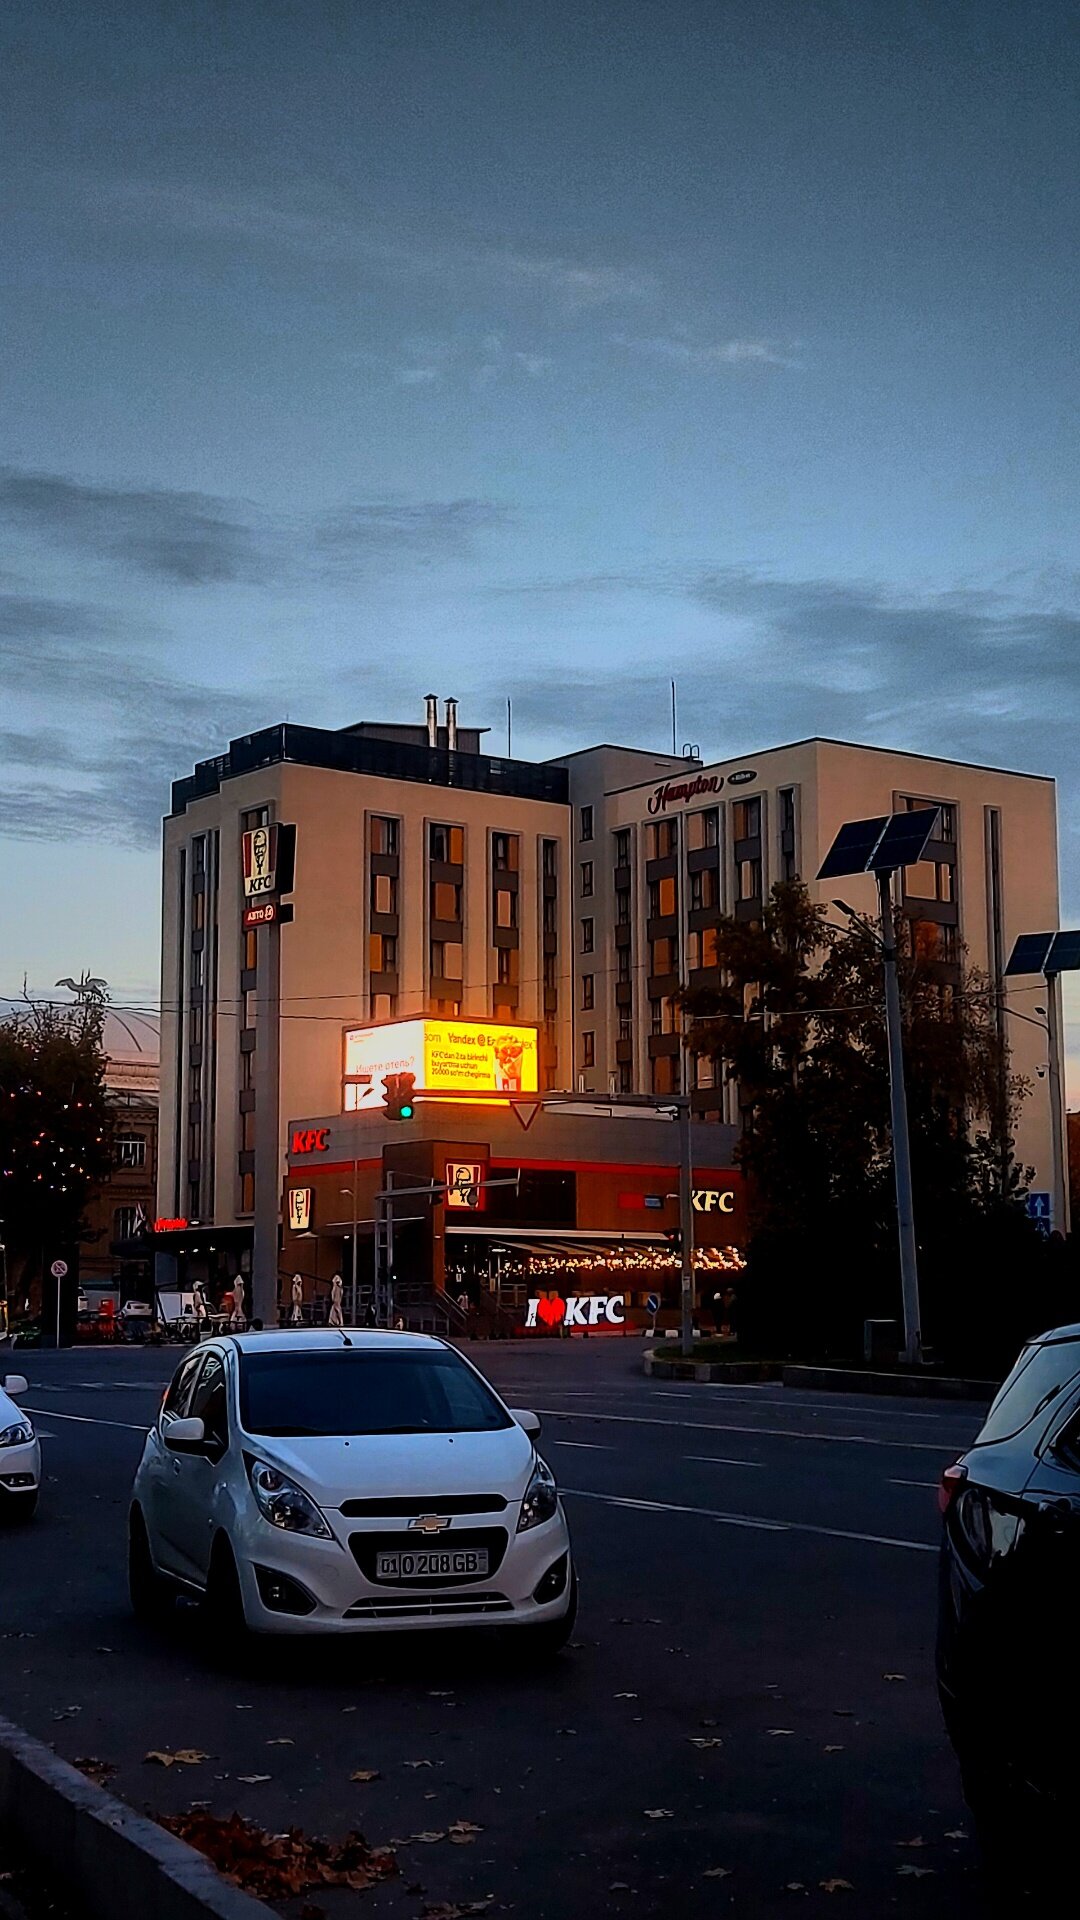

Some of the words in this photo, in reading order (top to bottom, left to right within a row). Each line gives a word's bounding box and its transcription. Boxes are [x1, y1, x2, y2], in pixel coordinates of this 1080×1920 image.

[648, 775, 724, 815] Hampton
[248, 875, 272, 893] KFC
[448, 1033, 476, 1045] Yandex
[292, 1128, 330, 1154] KFC
[691, 1190, 734, 1213] KFC
[525, 1298, 540, 1327] I
[563, 1295, 625, 1327] KFC
[381, 1558, 398, 1574] 01
[453, 1553, 478, 1573] GB
